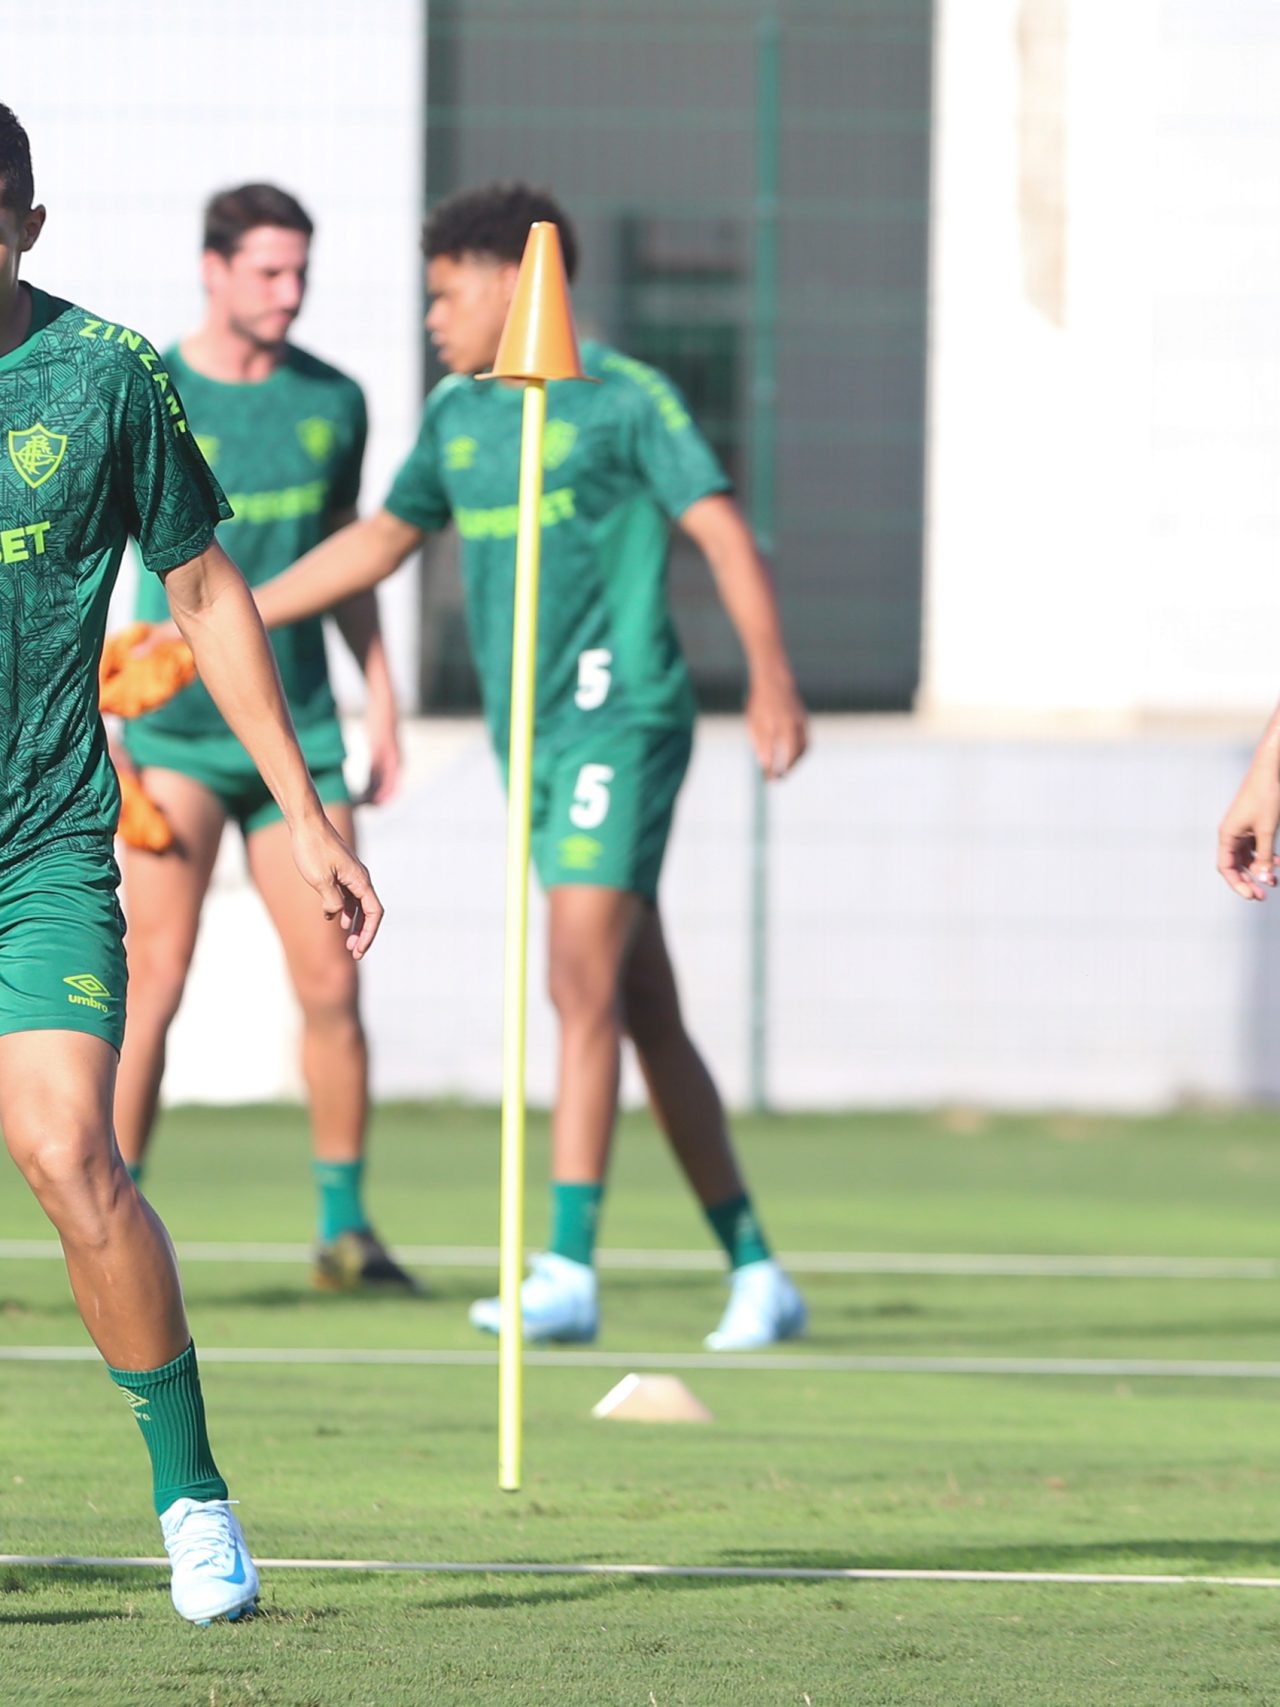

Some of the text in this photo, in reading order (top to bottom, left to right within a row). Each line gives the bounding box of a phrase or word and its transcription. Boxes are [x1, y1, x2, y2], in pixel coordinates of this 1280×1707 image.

[574, 647, 613, 711] 5
[569, 763, 615, 829] 5
[68, 993, 109, 1013] umbro
